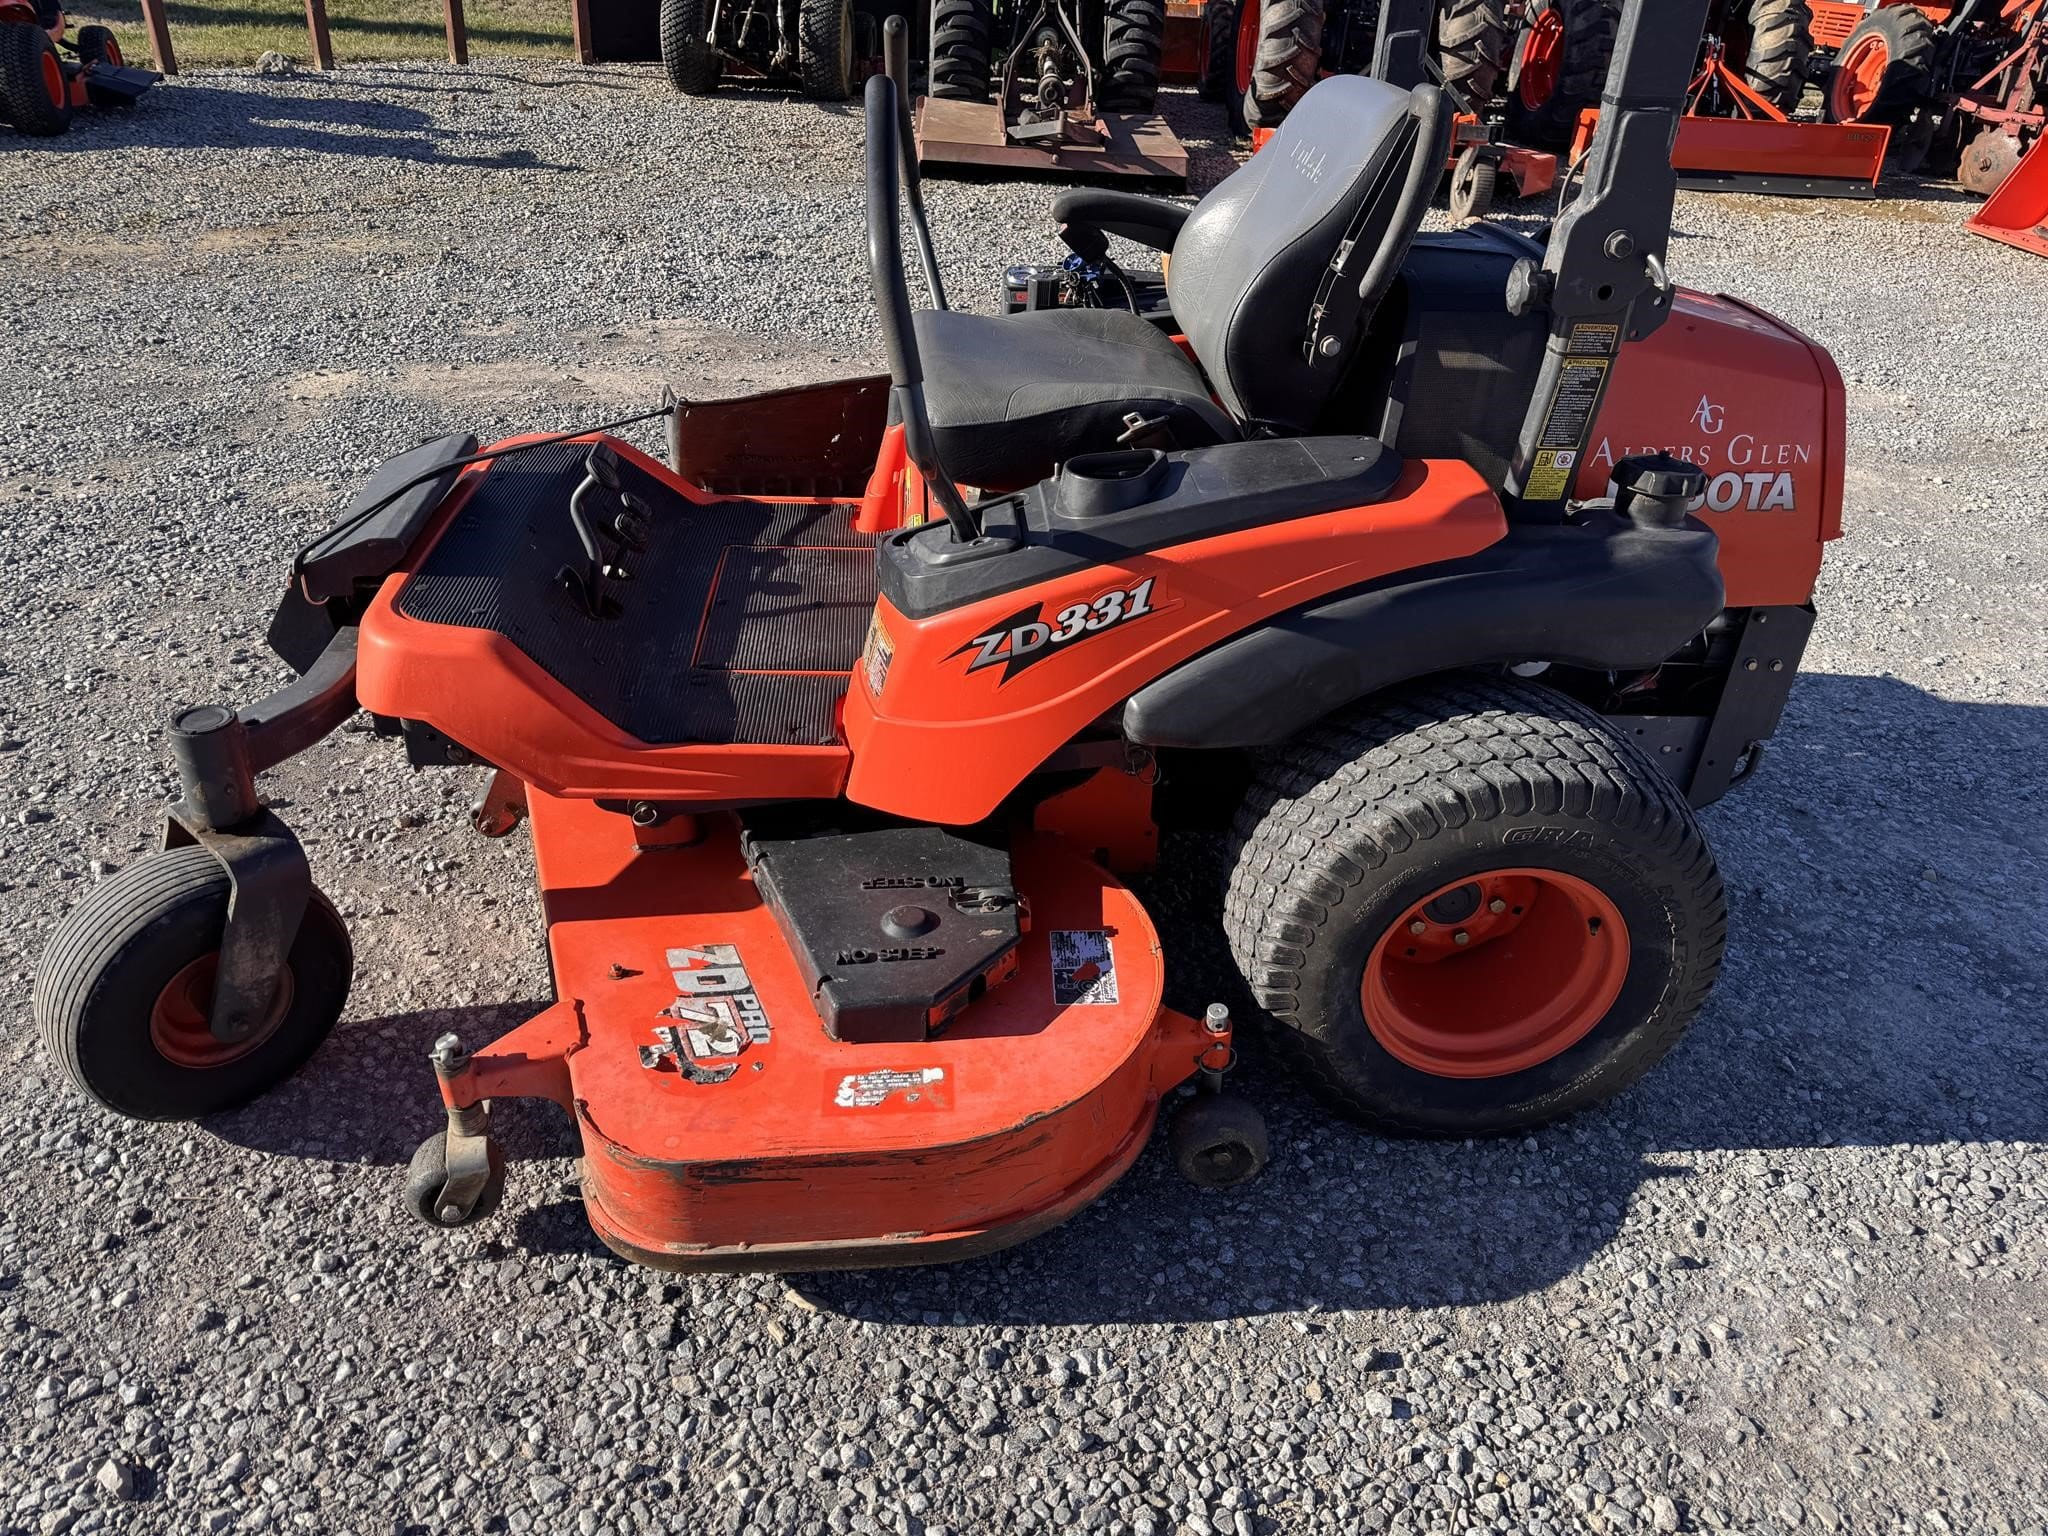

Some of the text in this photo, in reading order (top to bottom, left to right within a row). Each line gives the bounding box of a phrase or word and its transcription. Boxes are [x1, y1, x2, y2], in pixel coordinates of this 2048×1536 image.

[1690, 394, 1725, 434] AG
[1727, 434, 1811, 465] GLEN
[969, 578, 1155, 669] ZD331
[836, 946, 941, 965] NO STEP
[665, 944, 771, 1044] ZD PRO
[678, 1001, 742, 1057] 72
